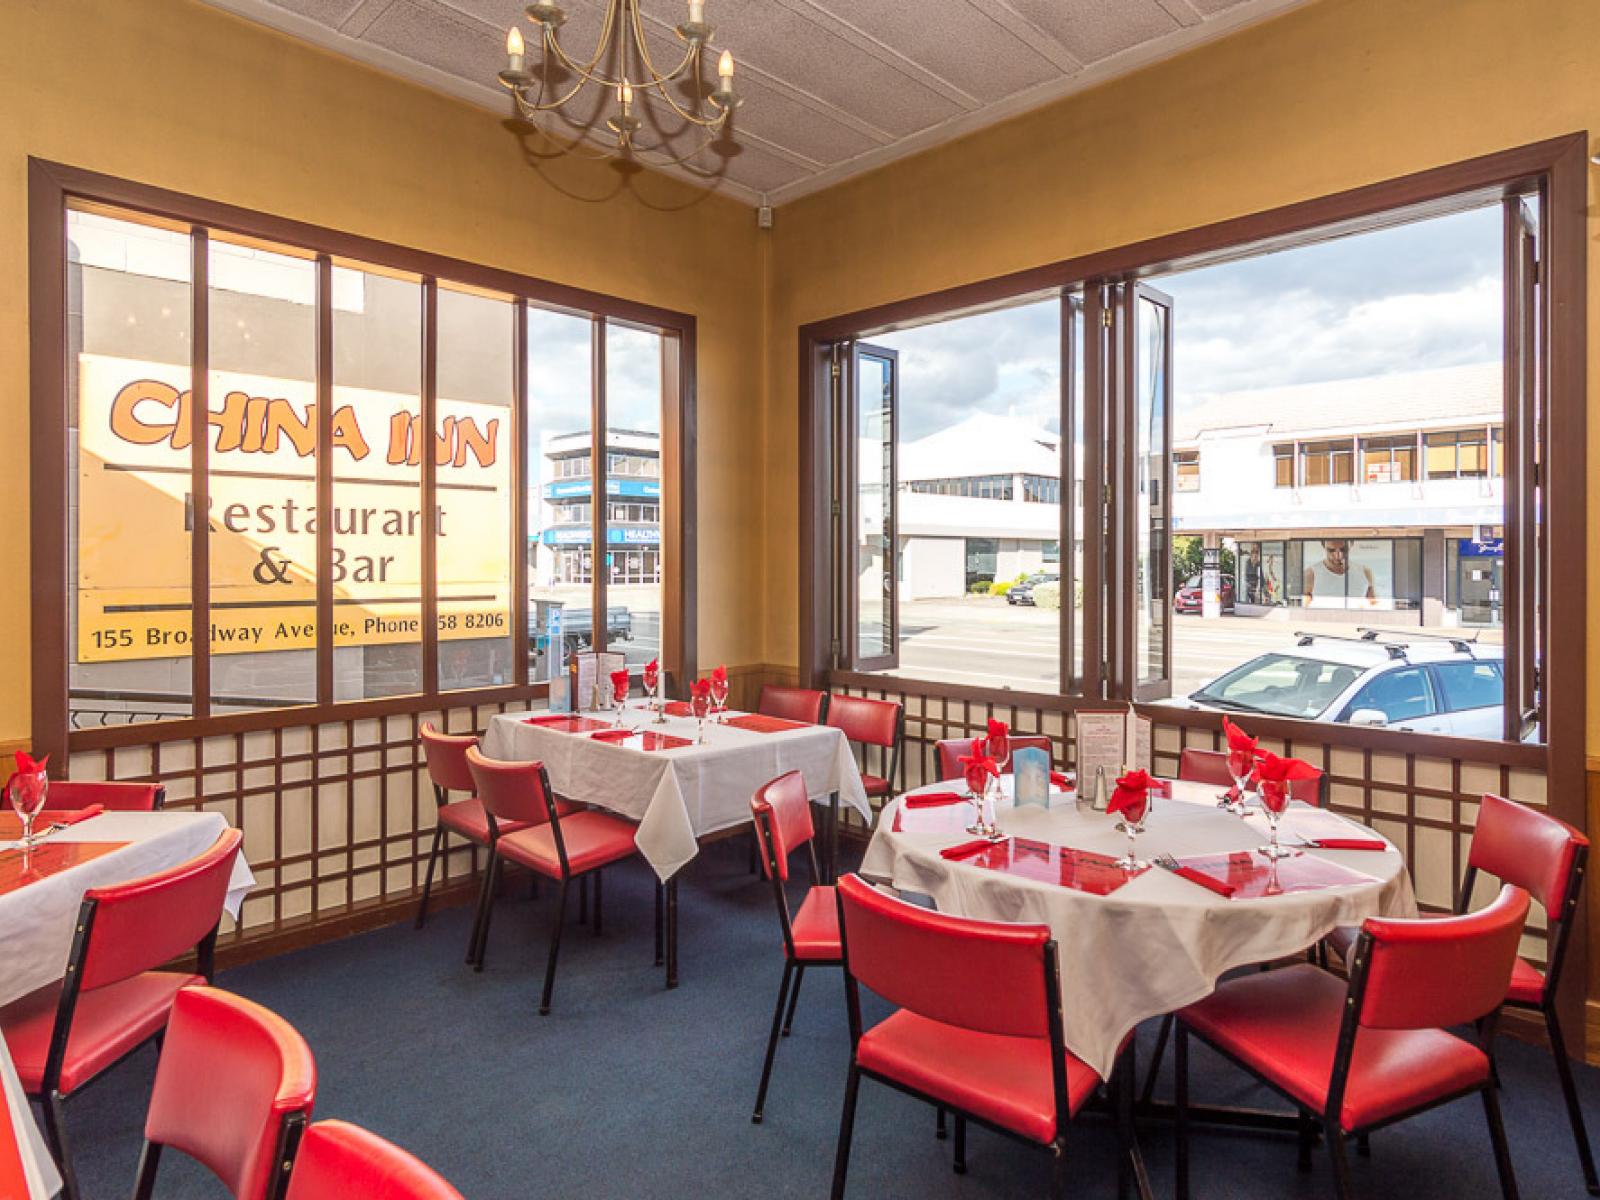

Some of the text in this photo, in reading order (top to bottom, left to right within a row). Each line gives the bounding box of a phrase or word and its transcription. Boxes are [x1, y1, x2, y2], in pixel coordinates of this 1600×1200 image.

[110, 379, 499, 468] CHINA INN
[253, 547, 293, 584] &
[91, 612, 504, 649] 155 Broway Avee, Phone 58 8206
